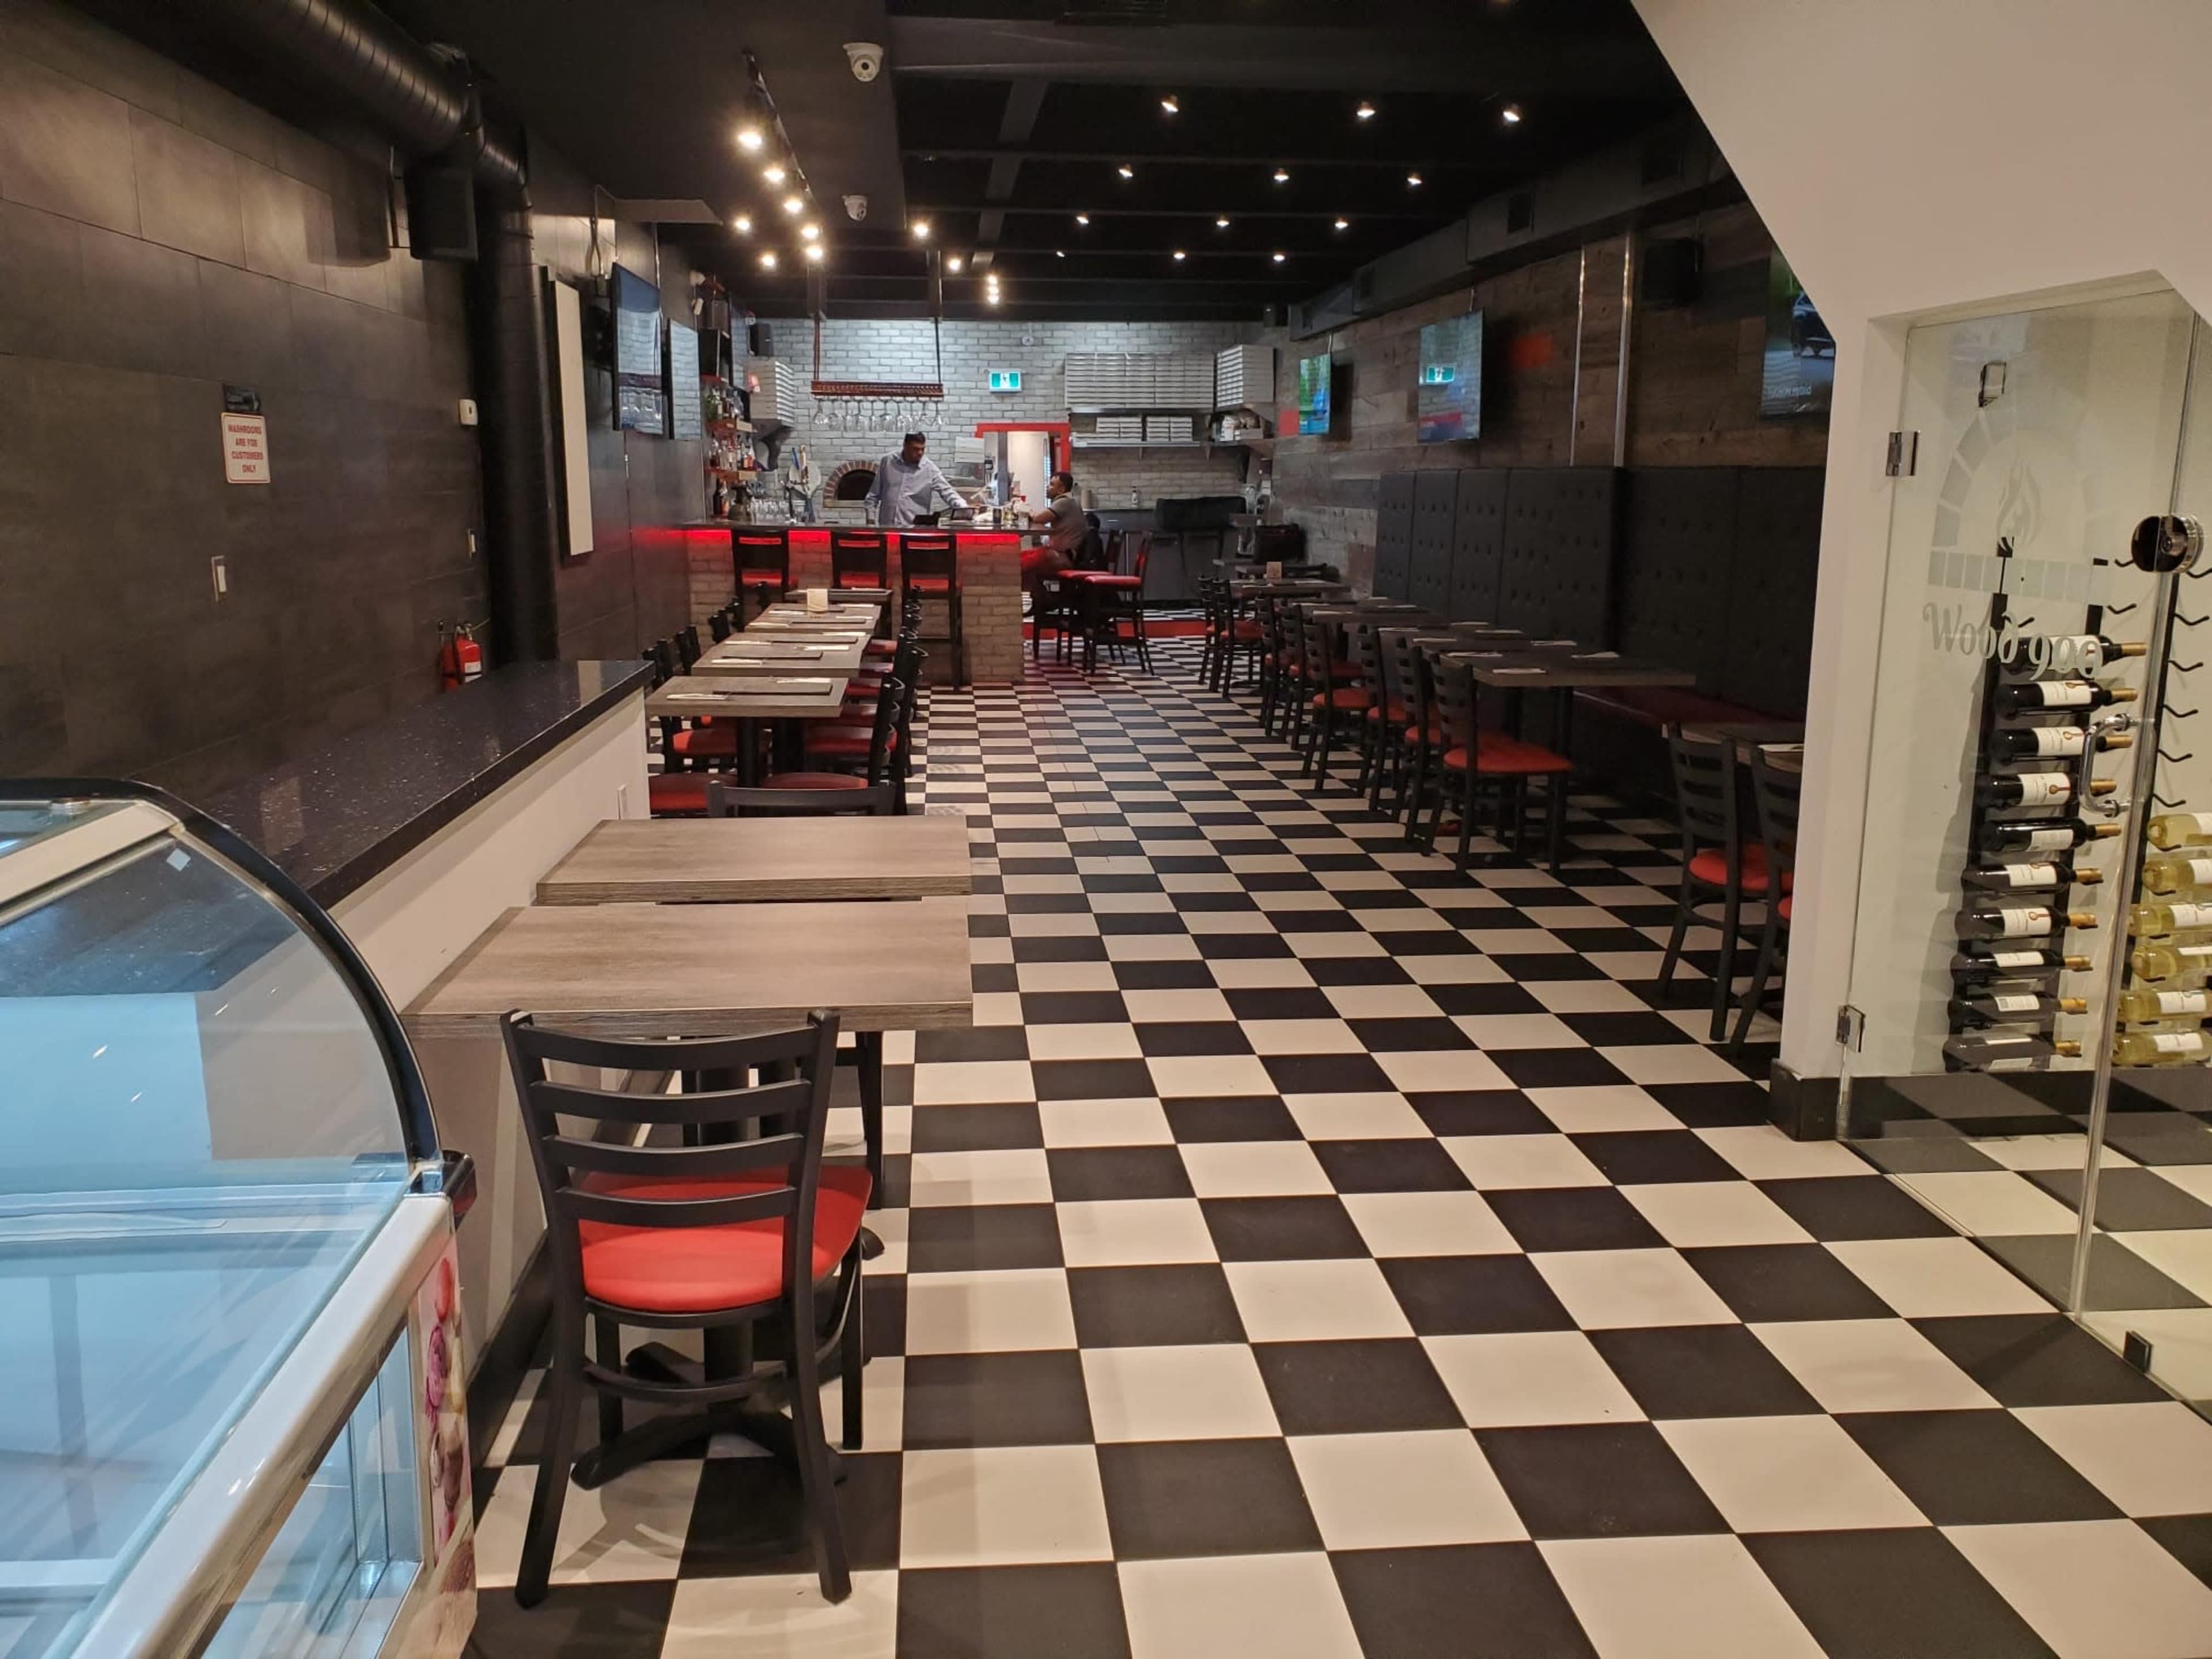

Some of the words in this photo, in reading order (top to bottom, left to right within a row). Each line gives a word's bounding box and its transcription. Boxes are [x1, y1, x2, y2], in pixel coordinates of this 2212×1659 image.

[228, 424, 262, 434] WASHROOMS
[235, 438, 246, 446] ARE
[232, 451, 264, 460] CUSTOMERS
[242, 465, 256, 473] ONLY
